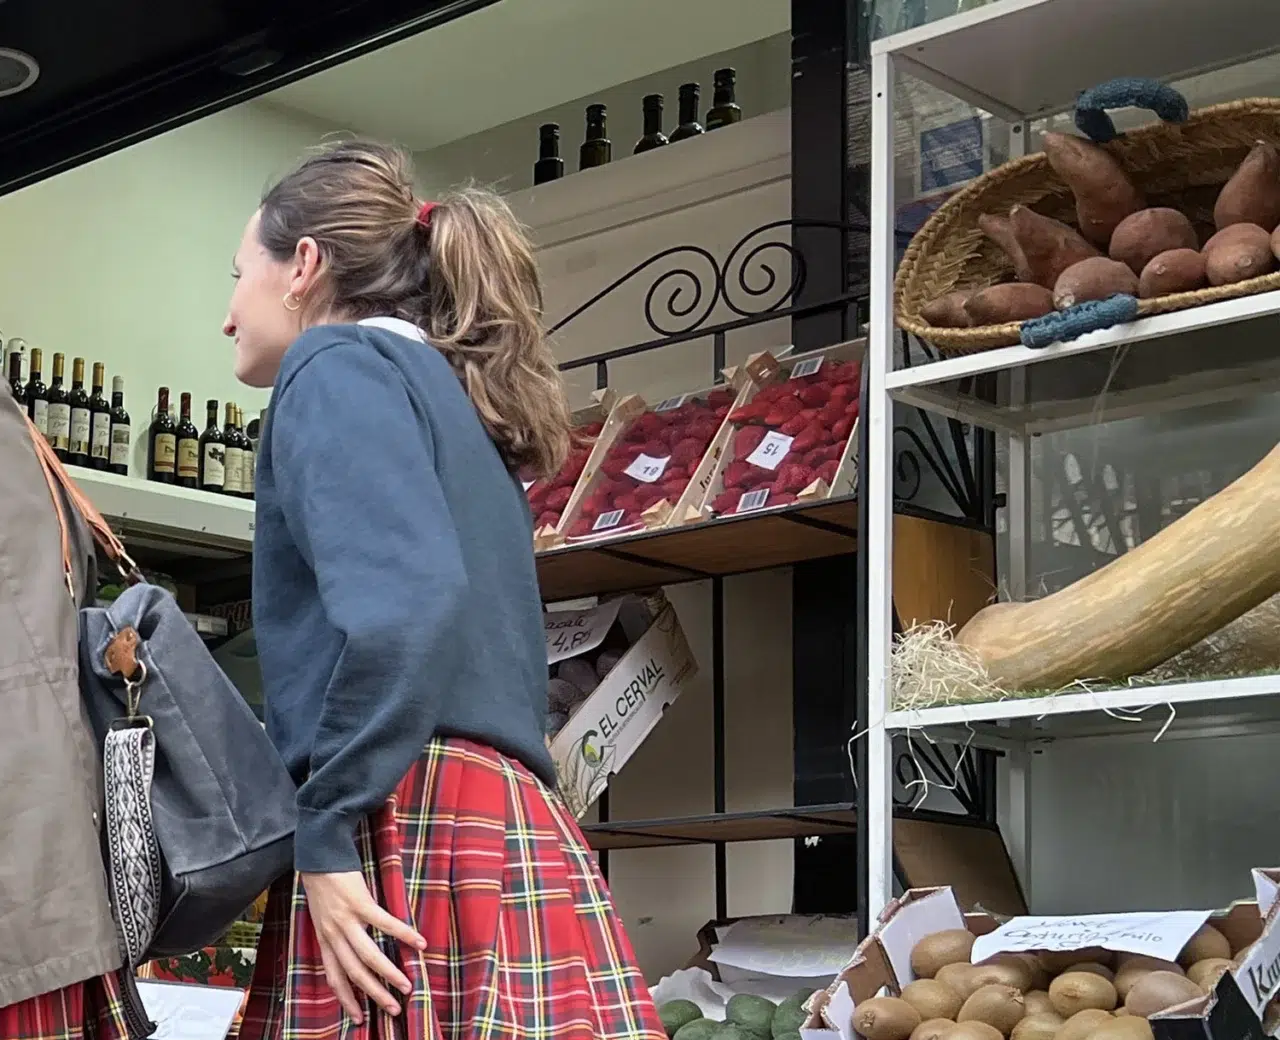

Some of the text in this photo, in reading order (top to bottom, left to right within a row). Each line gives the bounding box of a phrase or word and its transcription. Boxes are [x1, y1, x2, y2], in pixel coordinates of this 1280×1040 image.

[763, 443, 780, 456] 15
[643, 465, 659, 476] 19
[598, 713, 618, 738] EL
[616, 658, 663, 717] CERVAL
